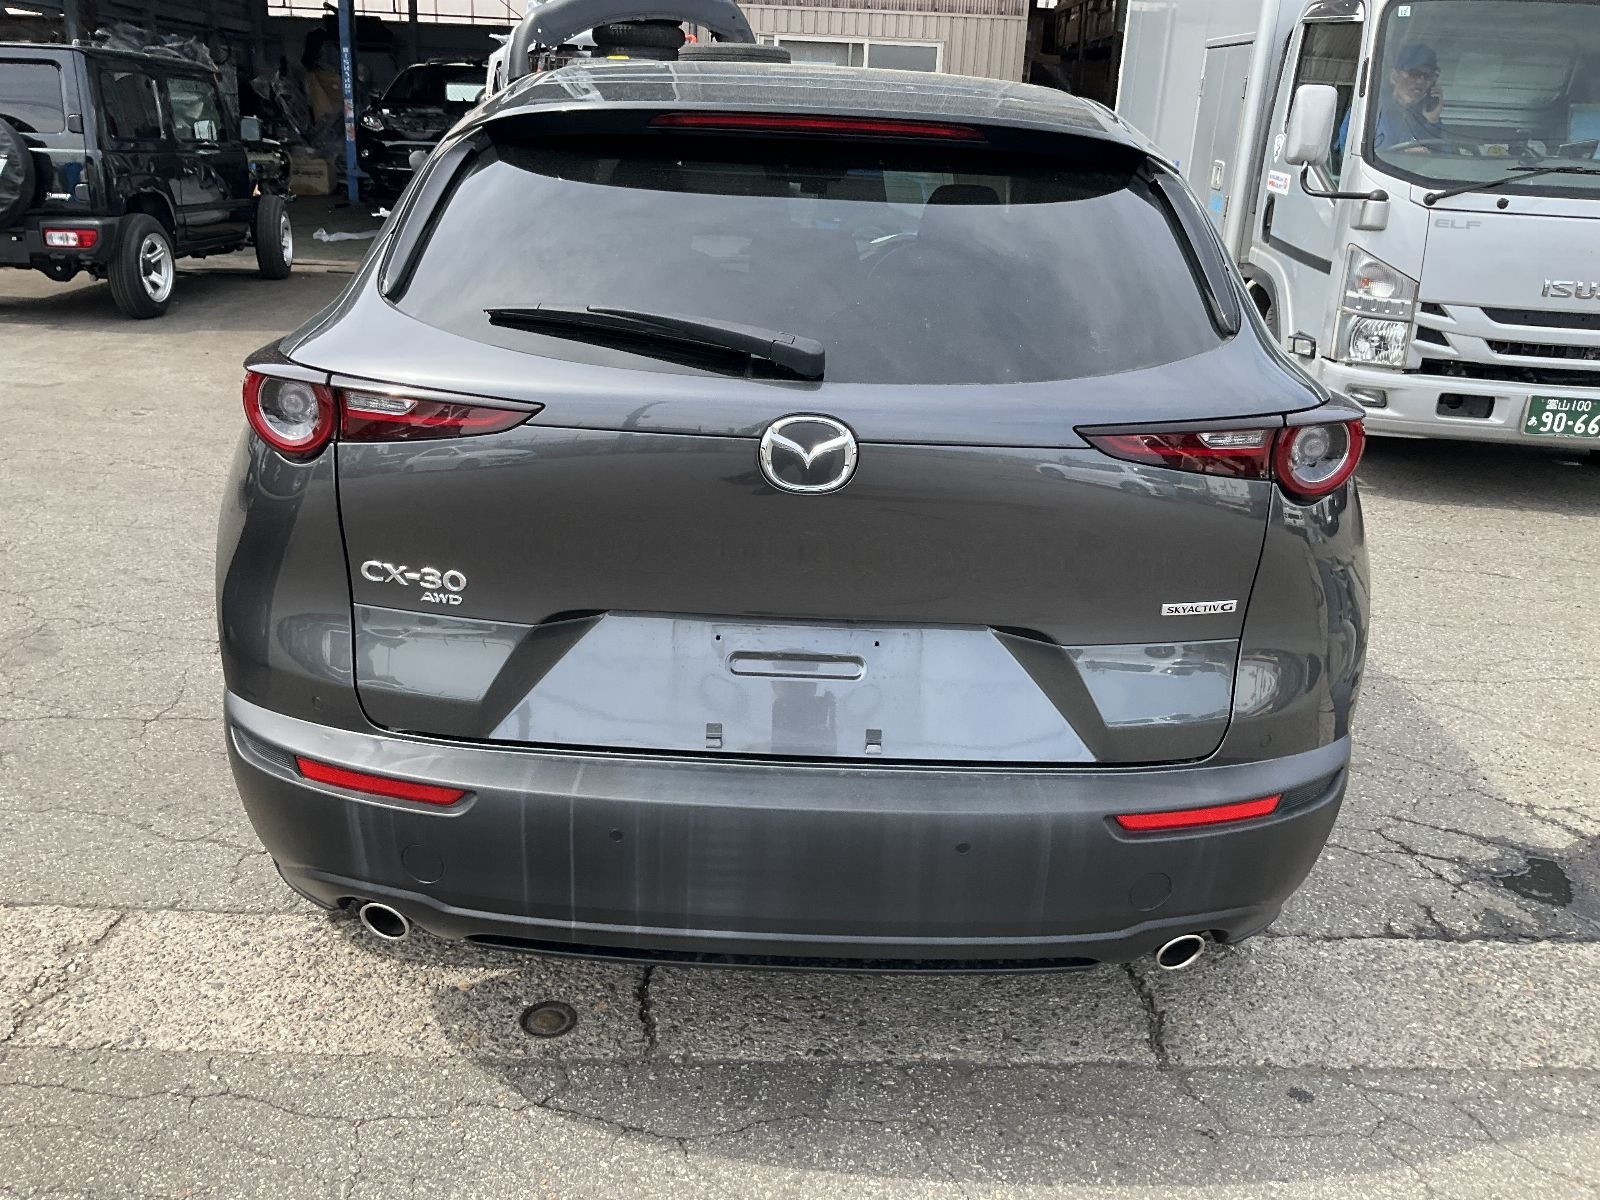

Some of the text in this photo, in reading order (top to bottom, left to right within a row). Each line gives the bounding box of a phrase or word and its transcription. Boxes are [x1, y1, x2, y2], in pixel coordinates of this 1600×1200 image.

[1434, 218, 1482, 230] ELF
[360, 560, 467, 592] CX-30
[420, 591, 463, 605] AWD
